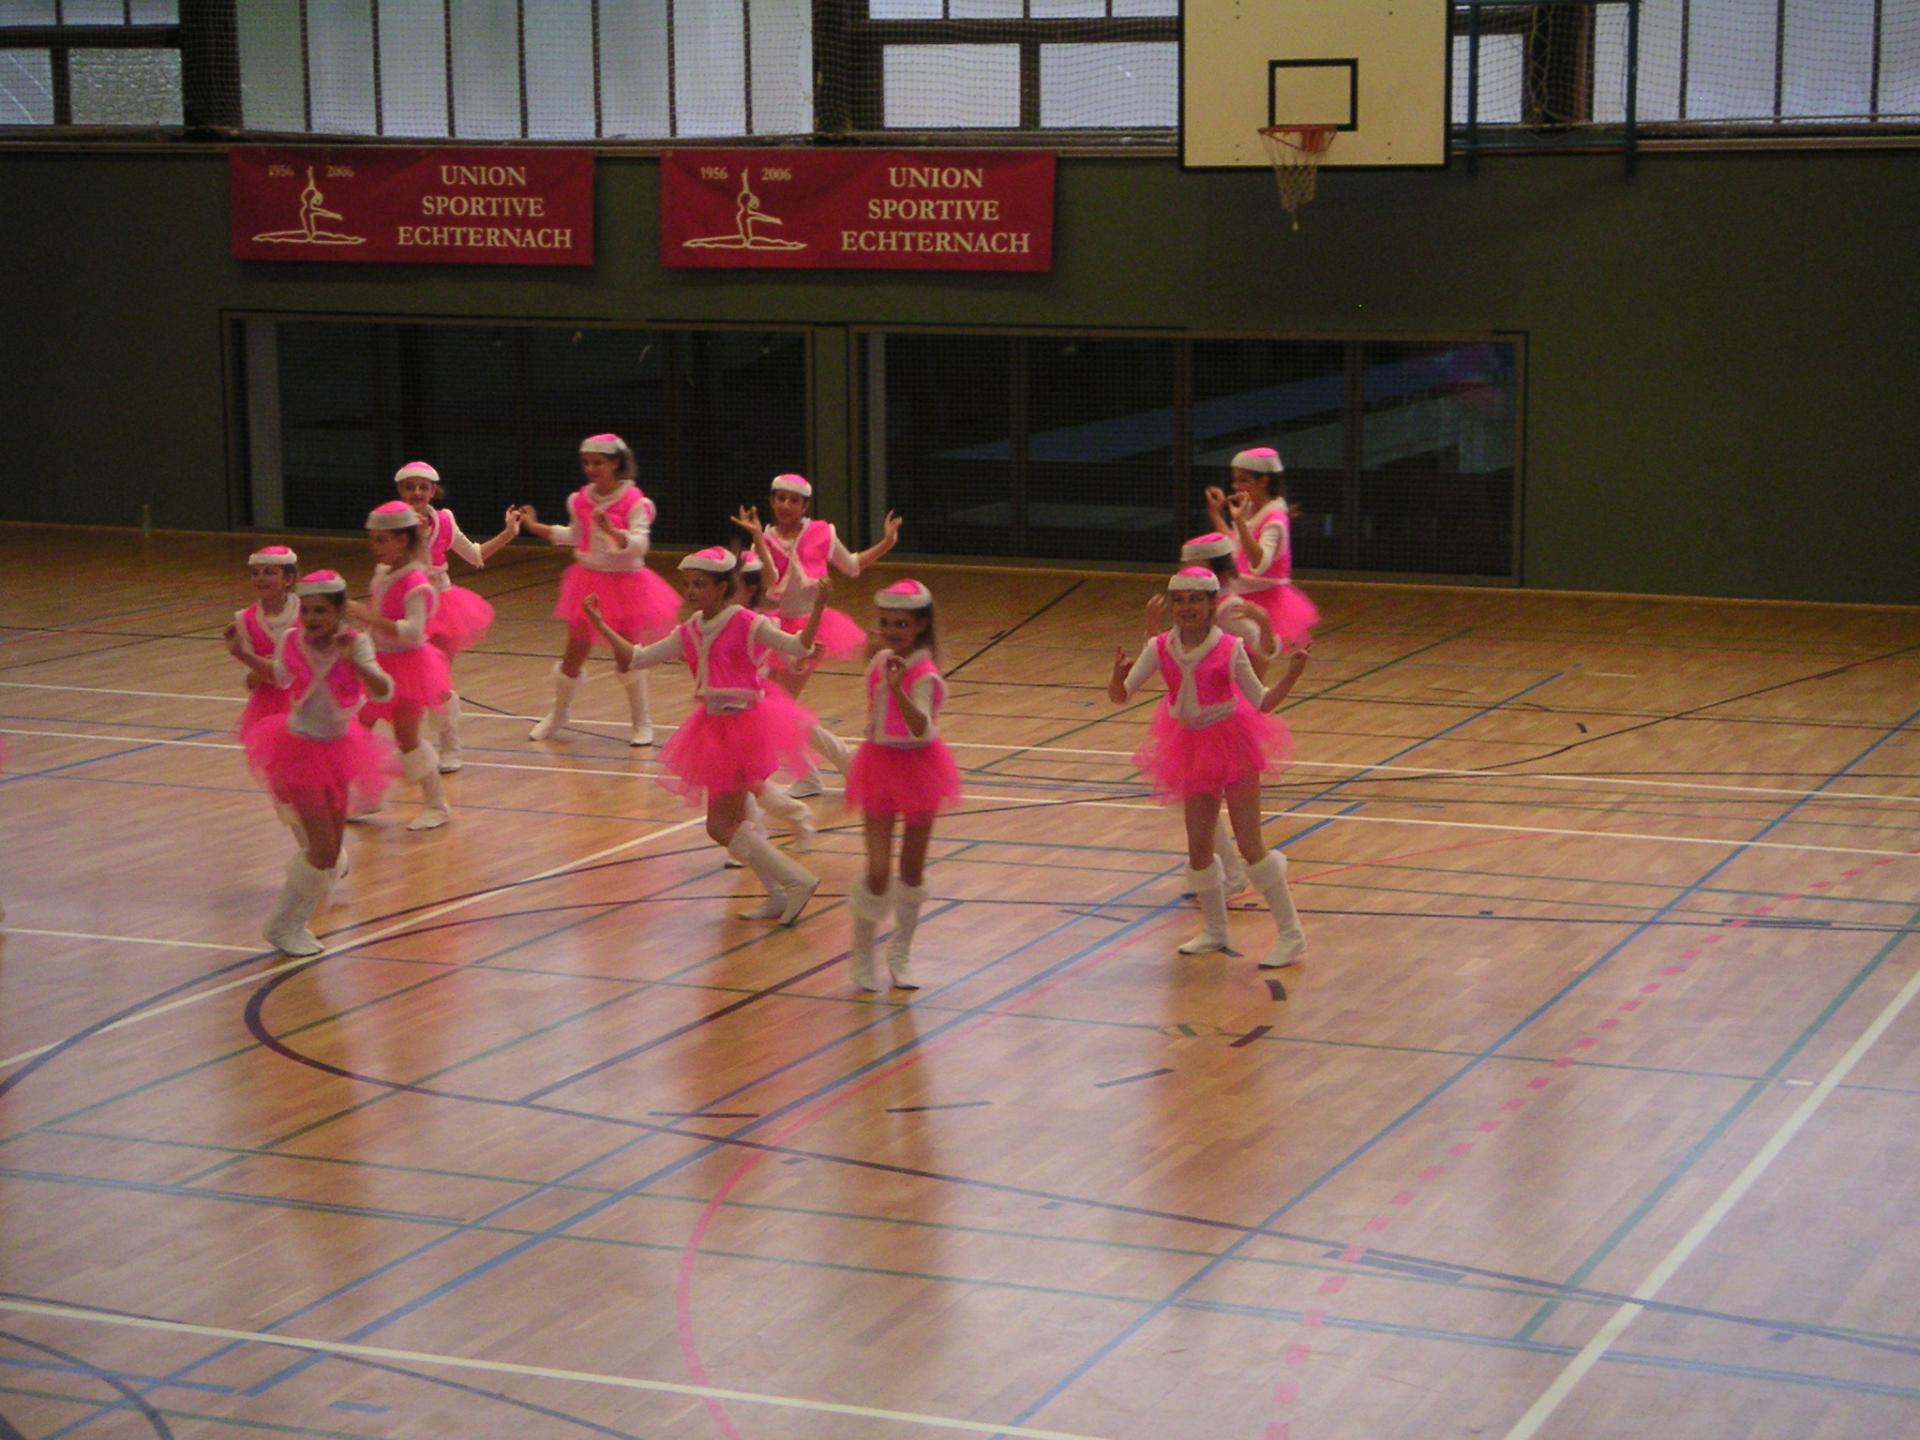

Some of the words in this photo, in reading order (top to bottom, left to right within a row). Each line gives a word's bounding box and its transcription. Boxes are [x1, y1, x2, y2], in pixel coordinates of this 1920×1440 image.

[440, 165, 526, 187] UNION
[700, 167, 728, 180] 1956
[761, 168, 791, 181] 2006
[888, 167, 983, 189] UNION
[422, 195, 545, 217] SPORTIVE
[868, 199, 999, 222] SPORTIVE
[397, 226, 573, 249] ECHTERNACH
[840, 230, 1031, 254] ECHTERNACH
